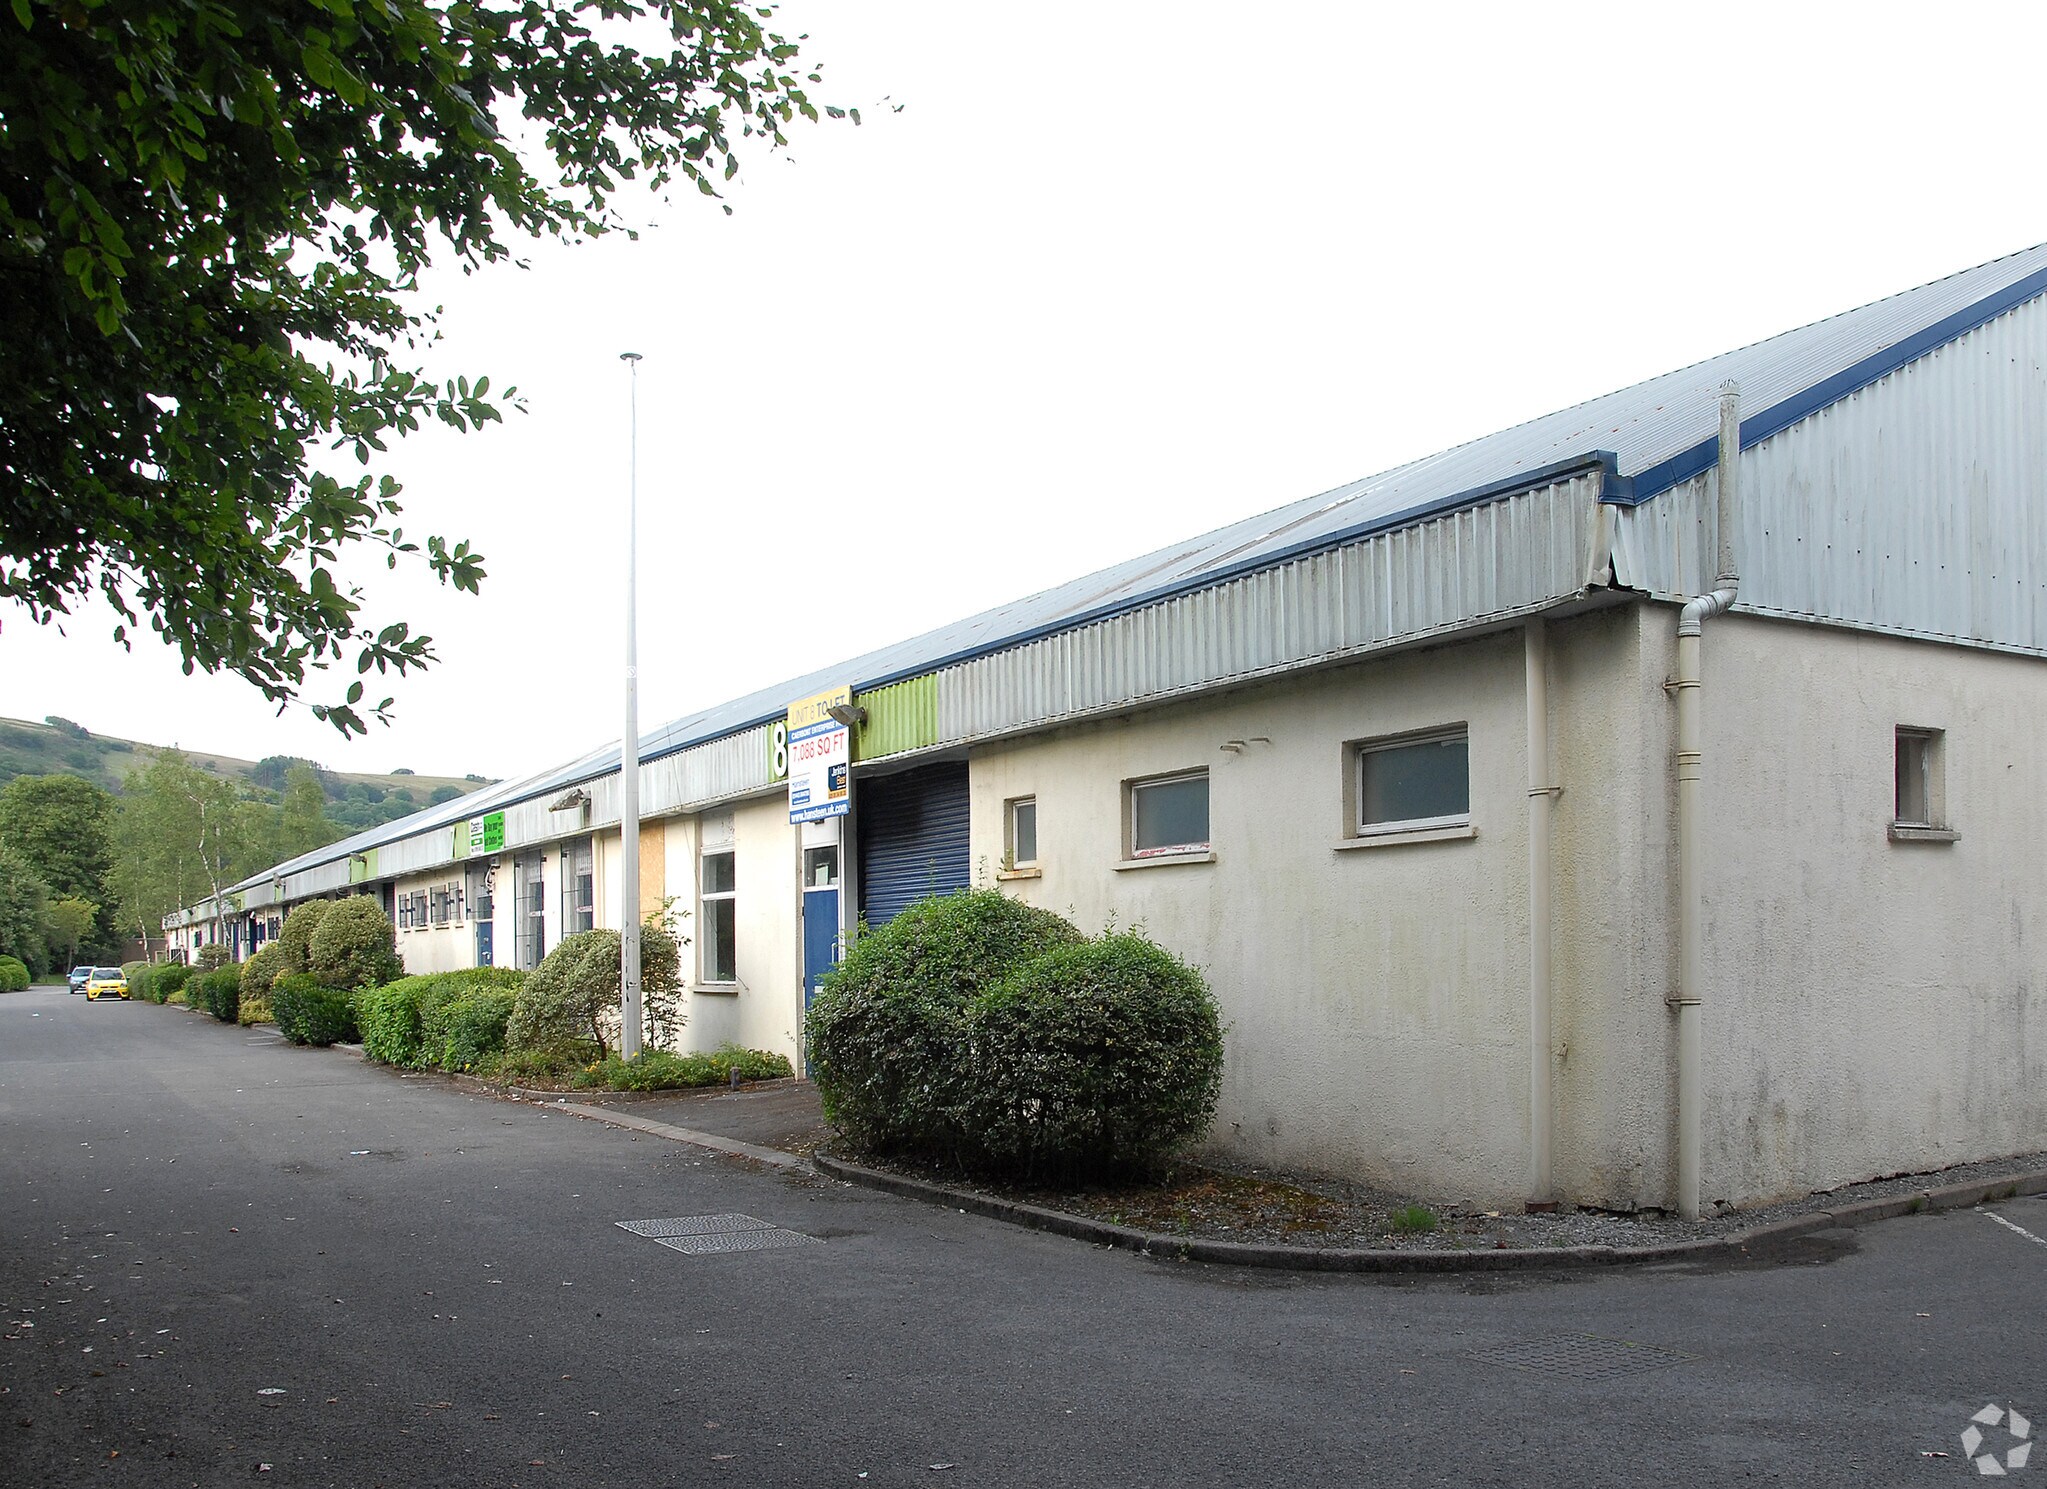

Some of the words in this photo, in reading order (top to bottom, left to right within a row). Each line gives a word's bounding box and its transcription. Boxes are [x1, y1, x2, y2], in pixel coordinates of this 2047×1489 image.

[792, 707, 808, 725] UNIT
[817, 701, 828, 716] TO
[774, 722, 787, 777] 8
[817, 736, 831, 756] SQ
[833, 732, 845, 752] FT
